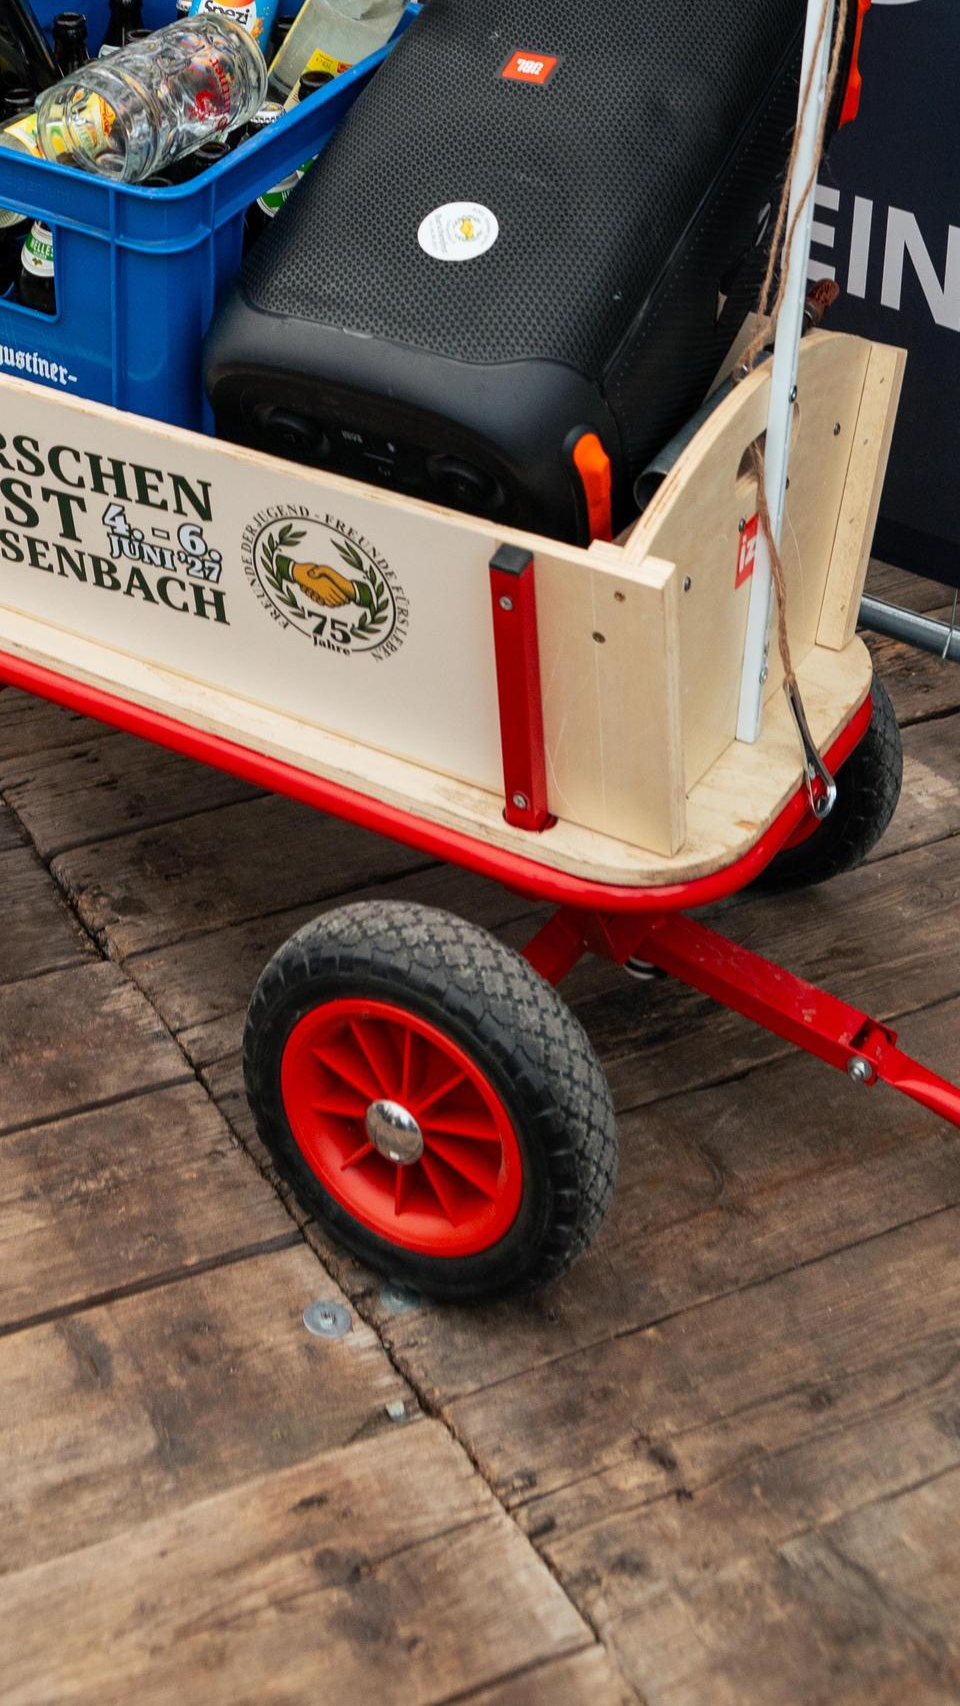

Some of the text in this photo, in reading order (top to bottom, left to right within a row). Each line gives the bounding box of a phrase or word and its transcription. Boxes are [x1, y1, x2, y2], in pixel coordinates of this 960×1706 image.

[101, 501, 145, 542] 4.
[177, 522, 223, 563] 6.
[106, 531, 177, 573] JUNI
[240, 525, 259, 554] DER
[253, 504, 311, 528] JUGEND
[323, 513, 399, 582] FREUNDE
[391, 584, 411, 624] FÜRS
[307, 610, 352, 644] 75
[312, 635, 351, 656] Jahre
